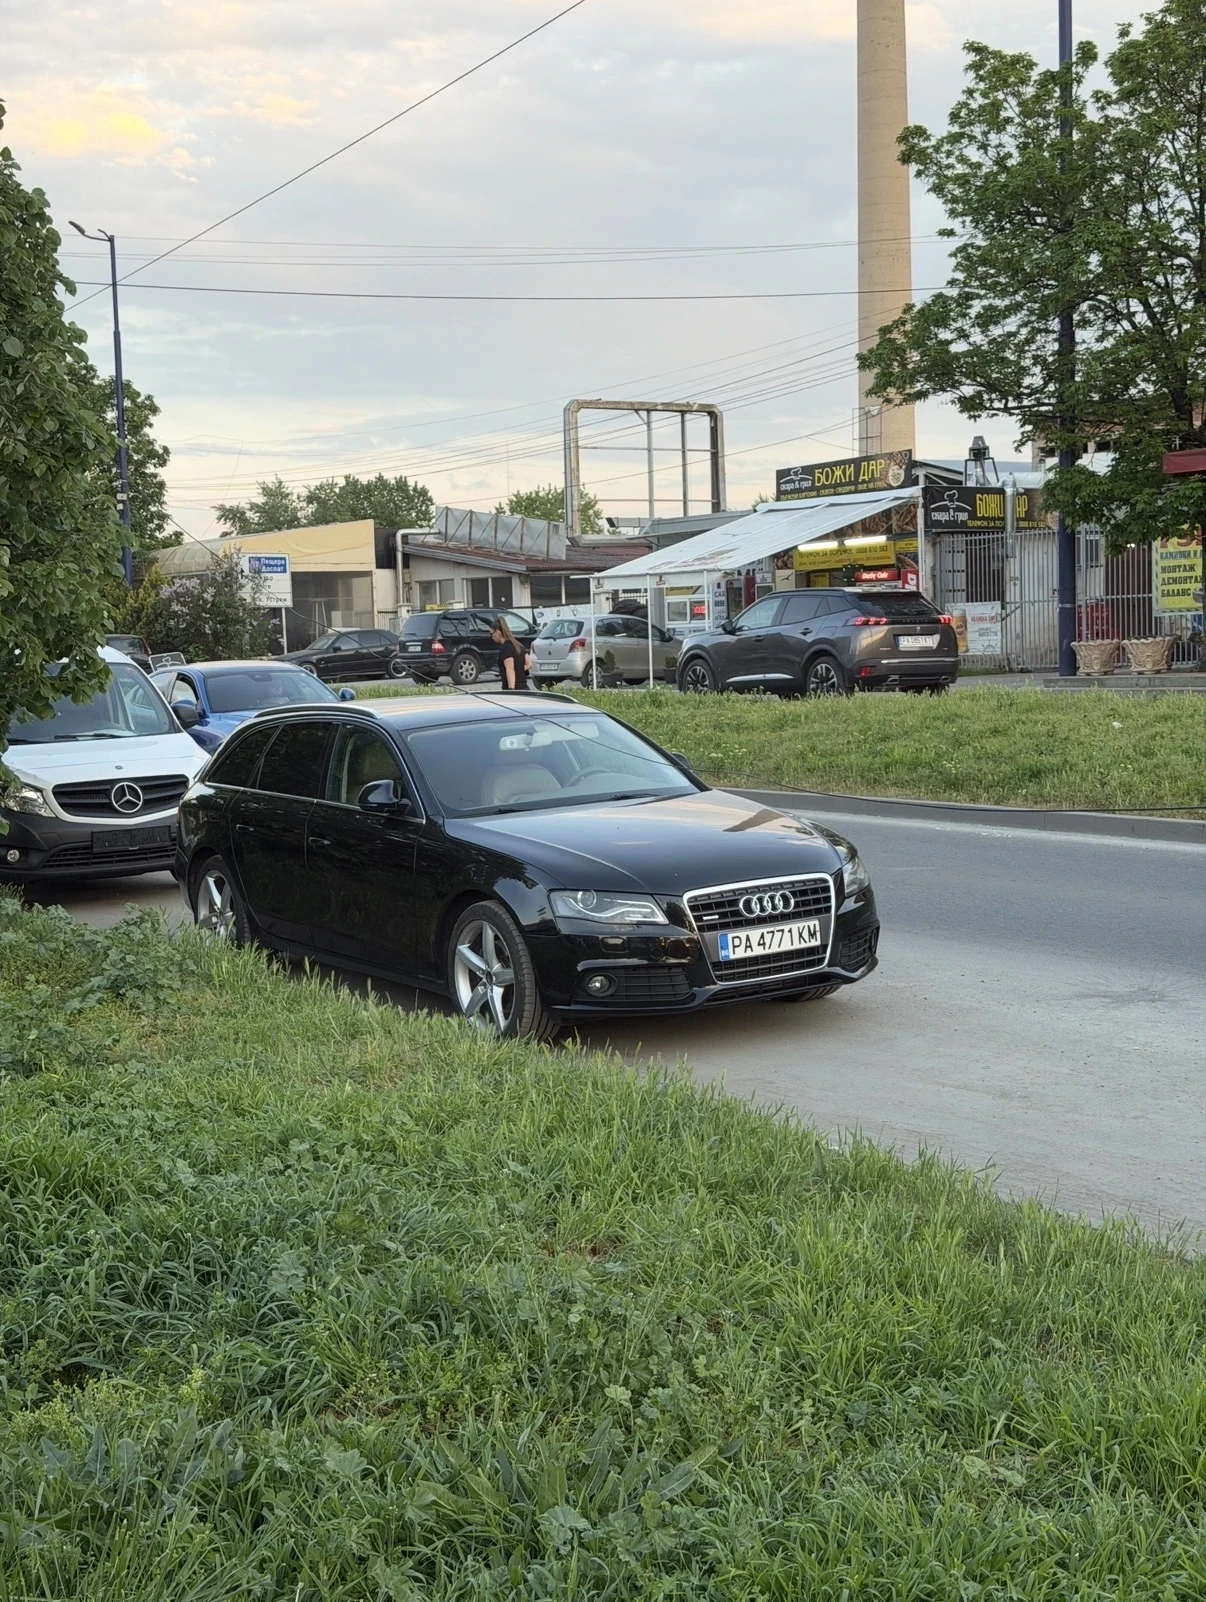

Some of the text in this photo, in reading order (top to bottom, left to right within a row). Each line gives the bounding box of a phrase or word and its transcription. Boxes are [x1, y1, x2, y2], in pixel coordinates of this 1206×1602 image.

[815, 459, 885, 486] БОЖИ ДАР
[976, 493, 1005, 518] БОЖИ
[931, 511, 949, 523] скара
[954, 512, 968, 524] грил
[1192, 549, 1198, 558] И
[260, 558, 285, 566] Пещера
[1161, 564, 1196, 574] МОНТАЖ
[1161, 588, 1191, 598] БАЛАНС
[731, 923, 818, 955] PA 4771 KM
